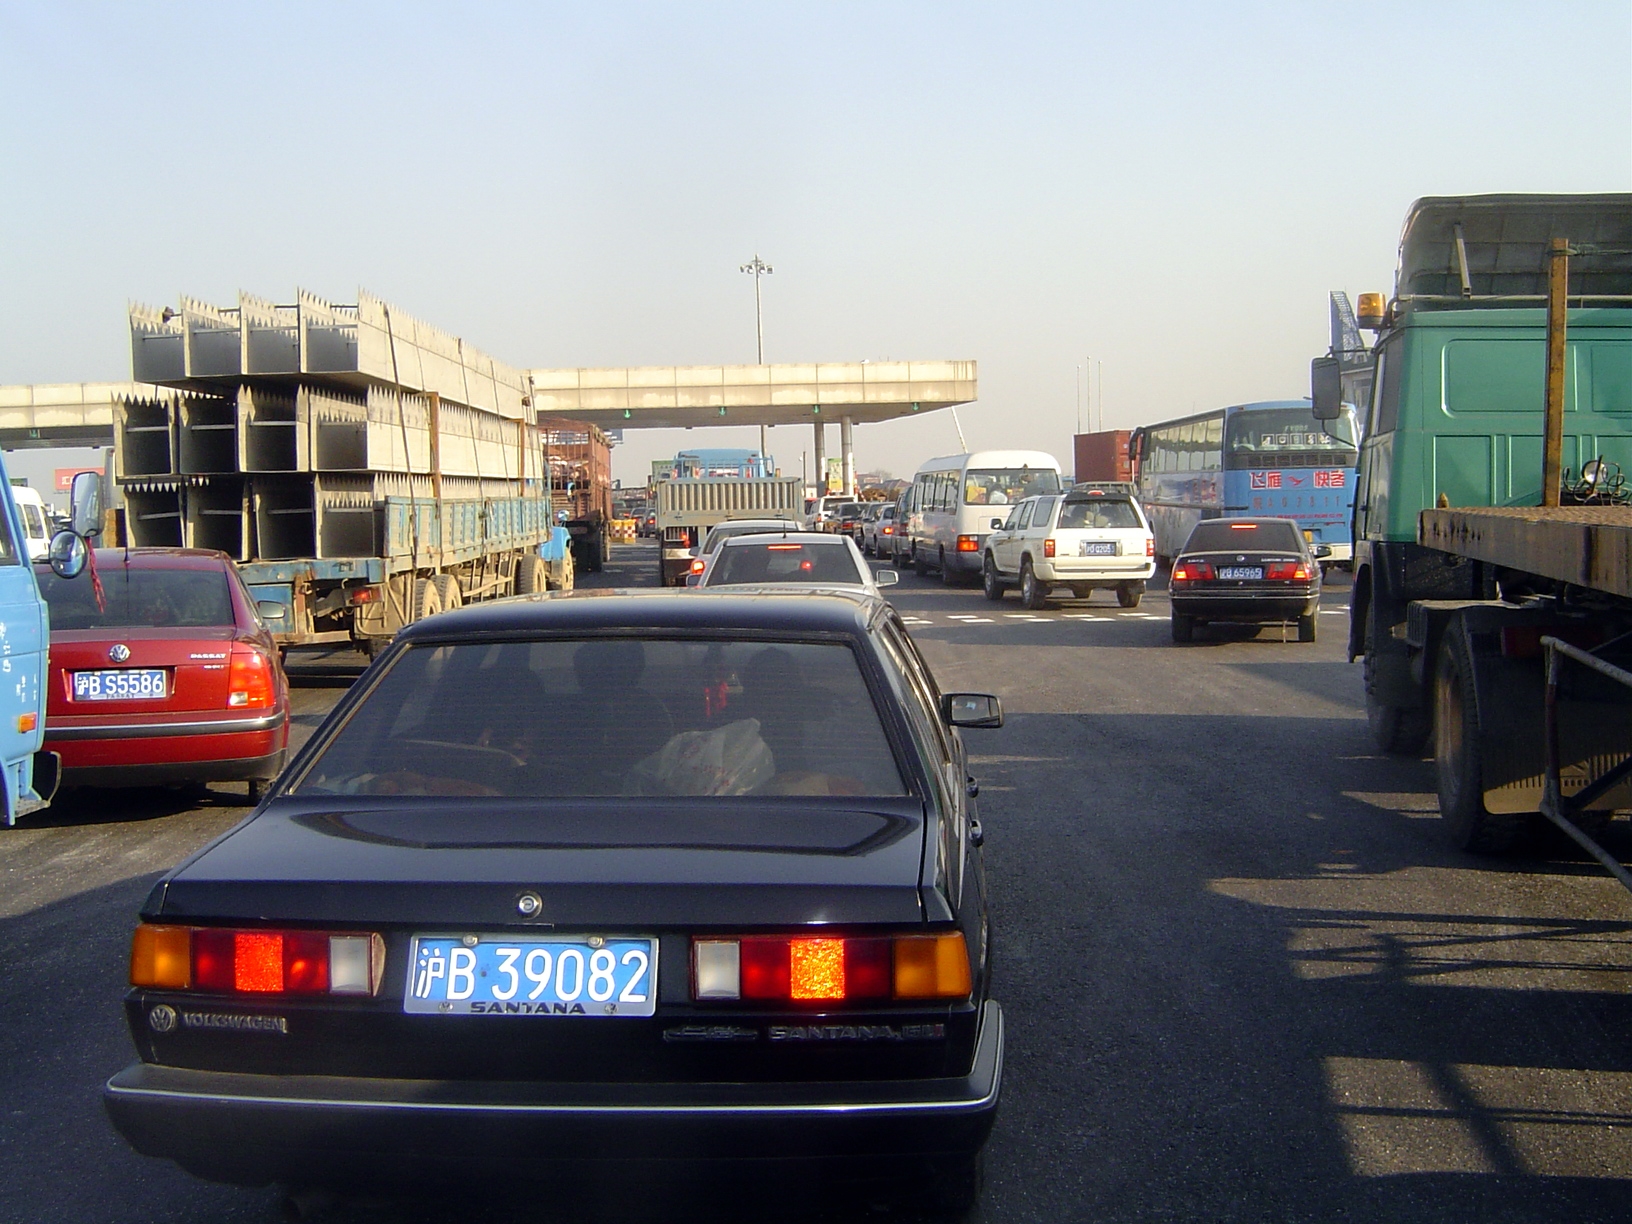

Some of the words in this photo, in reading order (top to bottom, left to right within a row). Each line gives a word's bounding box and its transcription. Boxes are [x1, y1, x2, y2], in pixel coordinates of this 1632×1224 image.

[1249, 471, 1282, 490] 飞雁
[1313, 469, 1345, 489] 快客
[105, 674, 164, 694] S5586
[416, 947, 477, 1000] 沪B
[490, 947, 649, 1003] 39082
[470, 1001, 587, 1014] SANTANA
[184, 1012, 288, 1034] VOLKSWAGEN
